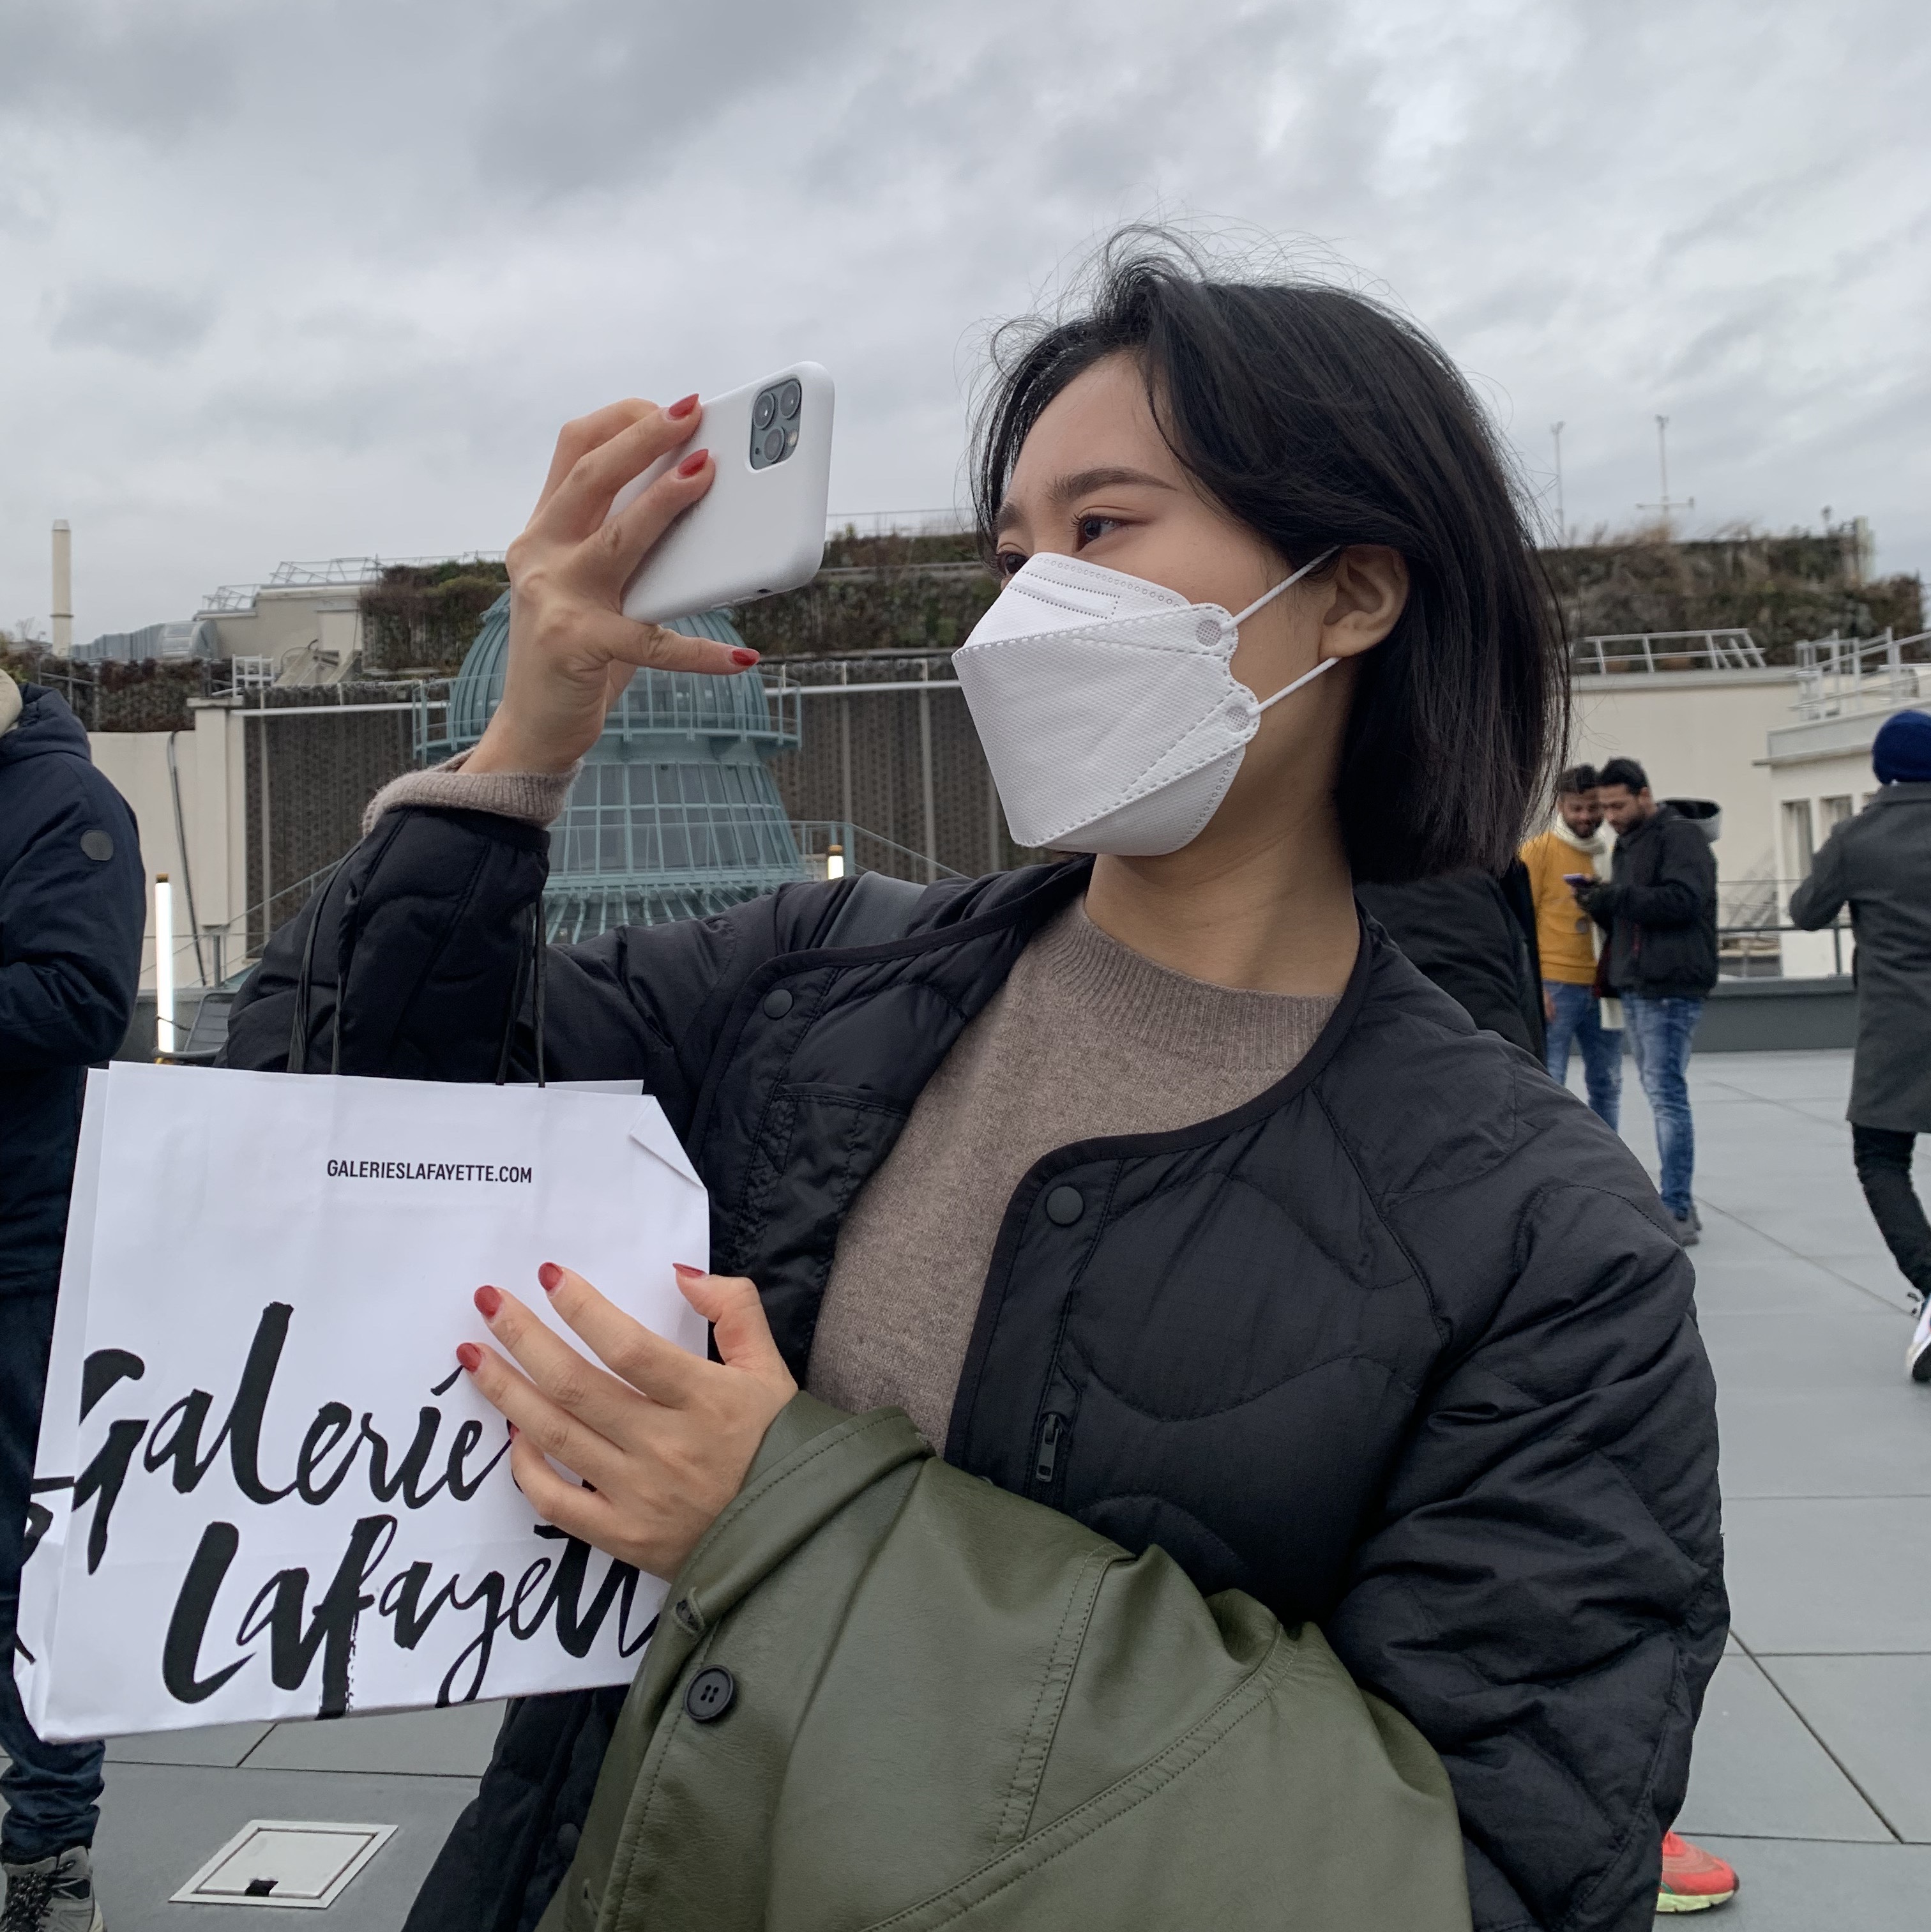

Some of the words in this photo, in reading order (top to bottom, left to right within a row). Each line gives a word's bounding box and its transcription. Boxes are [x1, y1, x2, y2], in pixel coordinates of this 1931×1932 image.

[327, 1159, 532, 1183] GALERIESLAFAYETTE.COM
[72, 1301, 524, 1574] Galerie
[162, 1515, 660, 1719] Lafayett
